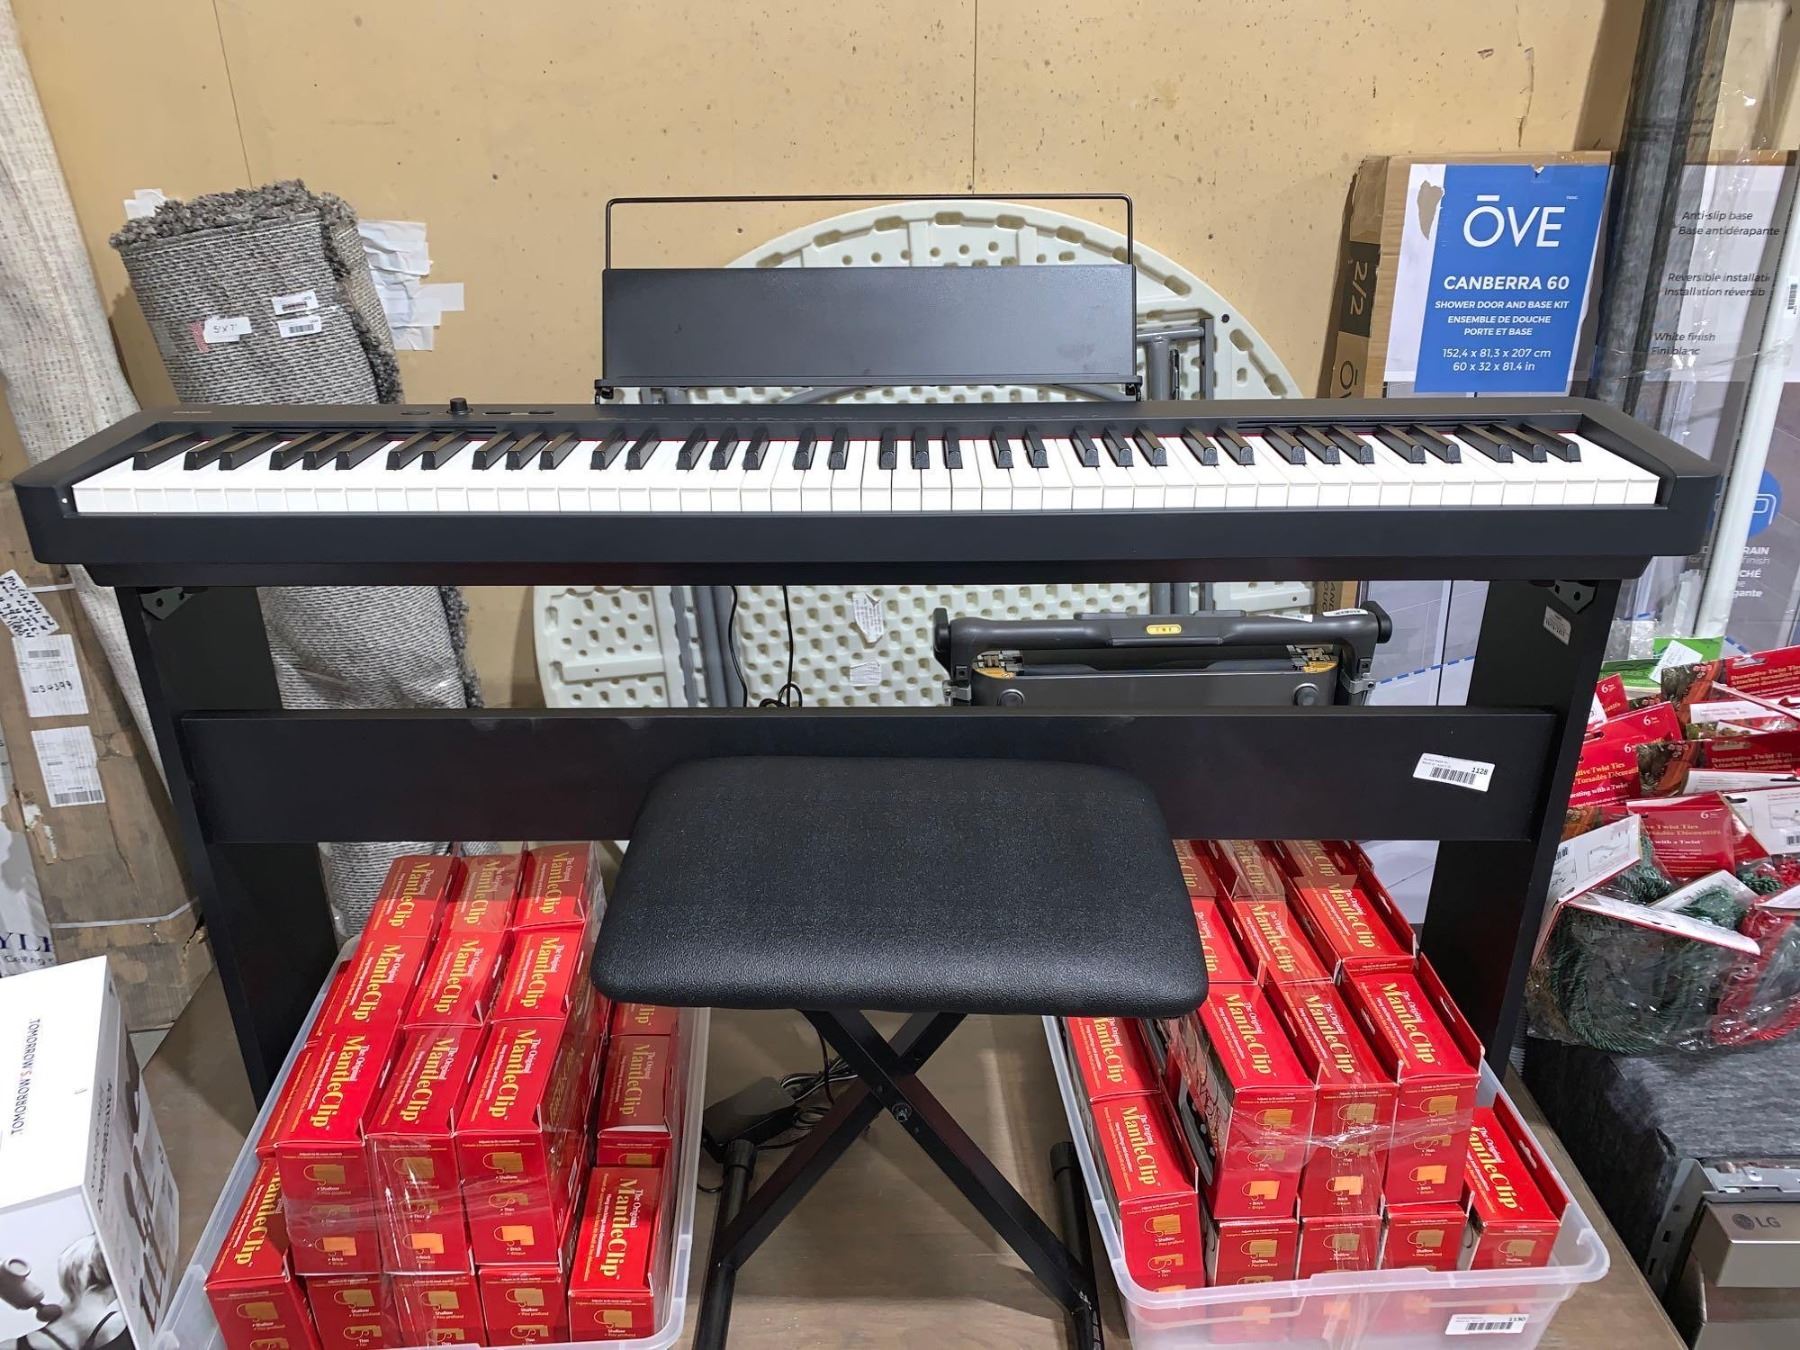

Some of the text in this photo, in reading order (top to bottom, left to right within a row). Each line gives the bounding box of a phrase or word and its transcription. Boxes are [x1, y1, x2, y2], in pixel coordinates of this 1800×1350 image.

[1682, 211, 1753, 222] Anti-slip base
[1678, 226, 1780, 237] Base antidérapante
[1350, 260, 1368, 316] 2/2
[1444, 276, 1570, 290] CANBERRA 60
[1668, 272, 1770, 282] Reversible installati
[1664, 287, 1766, 296] Installation réversib
[1435, 300, 1570, 309] SHOWER DOOR AND BASE KIT
[1448, 316, 1552, 324] ENSEMBLE DE DOUCHE
[1464, 328, 1533, 336] PORTE ET BASE
[1654, 332, 1686, 342] White
[1442, 348, 1470, 360] 152,4
[1480, 348, 1500, 359] 81,3
[1511, 348, 1532, 358] 207
[1453, 362, 1468, 372] 60
[1478, 362, 1492, 372] 32
[1502, 362, 1524, 372] 81.4
[1525, 362, 1536, 372] in
[1744, 546, 1770, 555] RAIN
[1740, 568, 1762, 578] CHÉ
[1733, 590, 1764, 598] gante
[1601, 684, 1608, 694] 6
[1643, 716, 1652, 726] 6
[1624, 743, 1632, 753] 6
[1700, 810, 1709, 819] 6
[540, 851, 570, 914] MantleClip
[389, 862, 432, 928] MantleClip
[1327, 883, 1376, 949] MantleClip
[1250, 904, 1294, 973] MantleClip
[352, 944, 402, 1020] MantleClip
[434, 939, 480, 1013] MantleClip
[522, 937, 560, 1008] MantleClip
[1250, 1011, 1265, 1034] Original
[1380, 982, 1436, 1064] MantleClip
[1224, 993, 1272, 1075] MantleClip
[1305, 995, 1354, 1074] MantleClip
[522, 1050, 538, 1074] Original
[310, 1036, 366, 1128] MantleClip
[400, 1038, 454, 1122] MantleClip
[488, 1029, 536, 1118] MantleClip
[620, 1044, 650, 1116] MantleClip
[1120, 1106, 1158, 1186] MantleClip
[1142, 1124, 1156, 1146] Original
[629, 1201, 644, 1228] Original
[1755, 1216, 1781, 1228] LG
[599, 1178, 638, 1278] MantleClip
